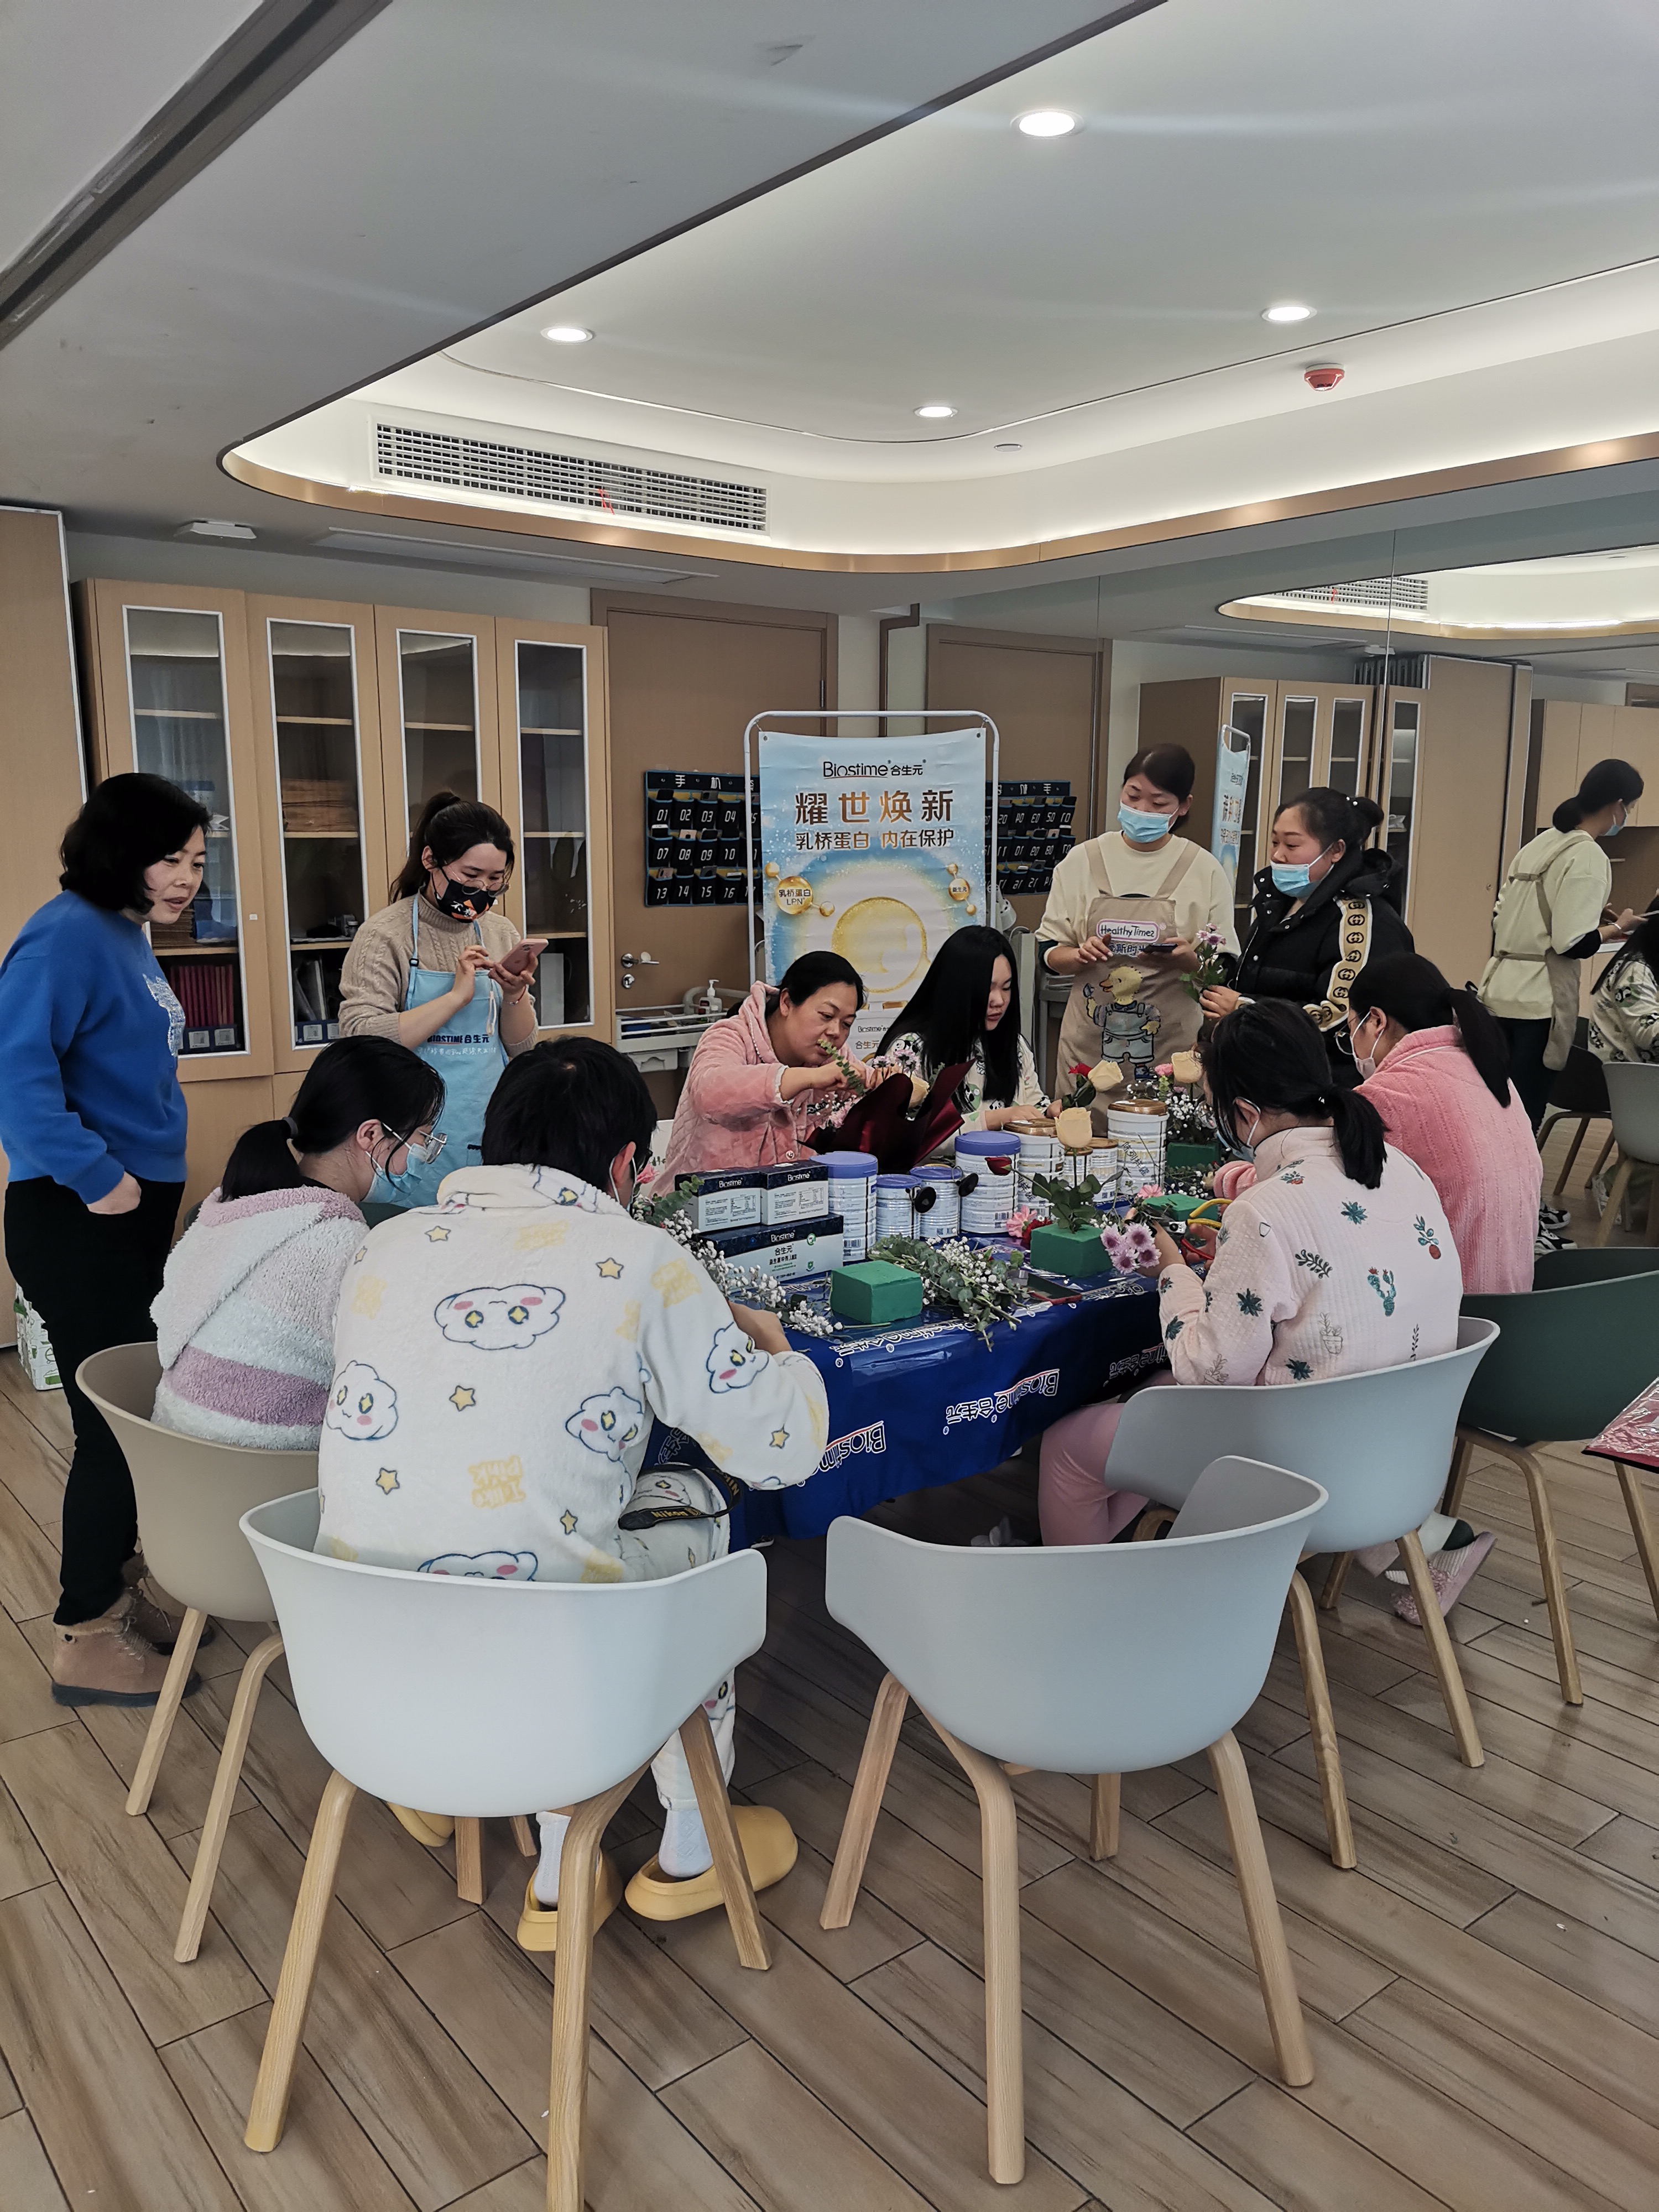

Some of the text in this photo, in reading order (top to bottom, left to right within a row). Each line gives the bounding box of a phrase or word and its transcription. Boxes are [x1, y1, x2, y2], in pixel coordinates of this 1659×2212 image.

[823, 761, 923, 778] Biostime 合生元
[795, 790, 953, 825] 耀世焕新
[657, 809, 668, 821] 01
[680, 809, 691, 821] 02
[701, 811, 713, 822] 03
[724, 810, 736, 822] 04
[796, 829, 954, 850] 乳桥蛋白 内在保护
[656, 848, 669, 860] 07
[679, 849, 691, 860] 08
[701, 849, 713, 861] 09
[724, 848, 735, 860] 10
[657, 888, 667, 899] 13
[679, 885, 690, 897] 14
[701, 886, 712, 898] 15
[724, 888, 735, 899] 16
[779, 889, 811, 897] 乳桥蛋白
[465, 1034, 489, 1044] 合生元
[855, 1040, 879, 1049] 合生元
[788, 1173, 810, 1181] Biostime
[719, 1180, 742, 1188] Biostime
[771, 1232, 795, 1242] Biostime
[775, 1245, 792, 1255] 合生元
[946, 1397, 994, 1425] 合生元
[651, 1510, 689, 1518] Nikon
